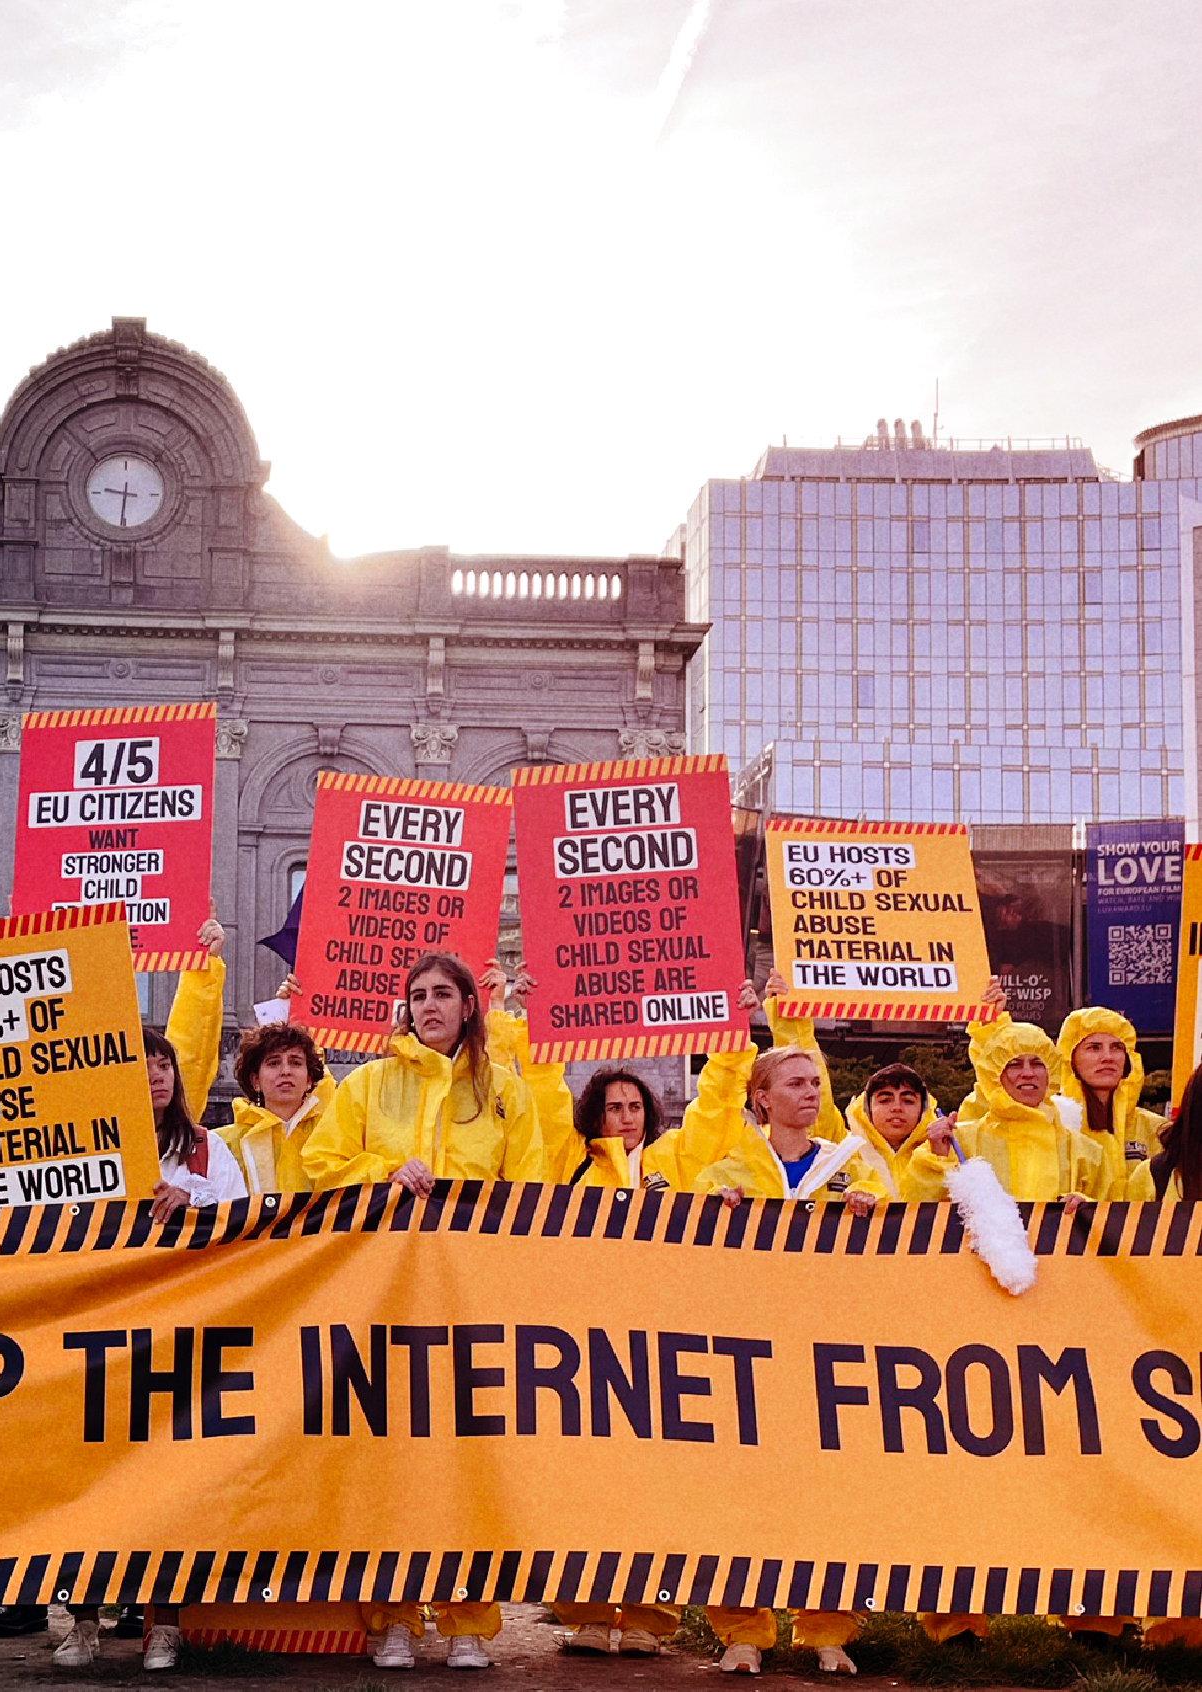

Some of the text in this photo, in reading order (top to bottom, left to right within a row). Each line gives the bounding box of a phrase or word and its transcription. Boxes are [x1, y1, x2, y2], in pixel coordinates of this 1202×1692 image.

[80, 740, 153, 785] 4/5
[37, 790, 195, 823] EU CITIZENS
[569, 786, 675, 829] EVERY
[362, 803, 462, 844] EVERY
[89, 828, 139, 850] WANT
[558, 831, 694, 875] SECOND
[1097, 840, 1180, 856] SHOW YOUR
[64, 853, 160, 875] STRONGER
[344, 844, 468, 887] SECOND
[788, 845, 911, 864] EU HOSTS
[789, 868, 907, 888] 60%+ OF
[1098, 855, 1181, 885] LOVE
[84, 878, 138, 899] CHILD
[338, 886, 464, 919] 2 IMAGES OR
[559, 876, 698, 908] 2 IMAGES OR
[791, 892, 973, 912] CHILD SEXUAL
[1116, 886, 1159, 895] EUROPEAN
[348, 914, 450, 944] VIDEOS OF
[573, 906, 687, 937] VIDEOS OF
[794, 914, 876, 935] ABUSE
[326, 939, 383, 965] CHILD
[556, 935, 710, 968] CHILD SEXUAL
[795, 938, 954, 961] MATERIAL IN
[335, 968, 400, 996] ABUSE
[574, 966, 697, 997] ABUSE ARE
[795, 963, 951, 987] THE WORLD
[310, 994, 389, 1023] SHARED
[1005, 988, 1051, 1000] E-WISP
[29, 998, 65, 1032] OF
[550, 994, 725, 1028] SHARED ONLINE
[31, 1031, 137, 1075] SEXUAL
[91, 1117, 121, 1150] IN
[18, 1160, 120, 1202] WORLD
[63, 1327, 256, 1443] THE
[300, 1324, 772, 1446] INTERNET
[812, 1342, 1102, 1457] FROM
[1131, 1349, 1202, 1458] S
